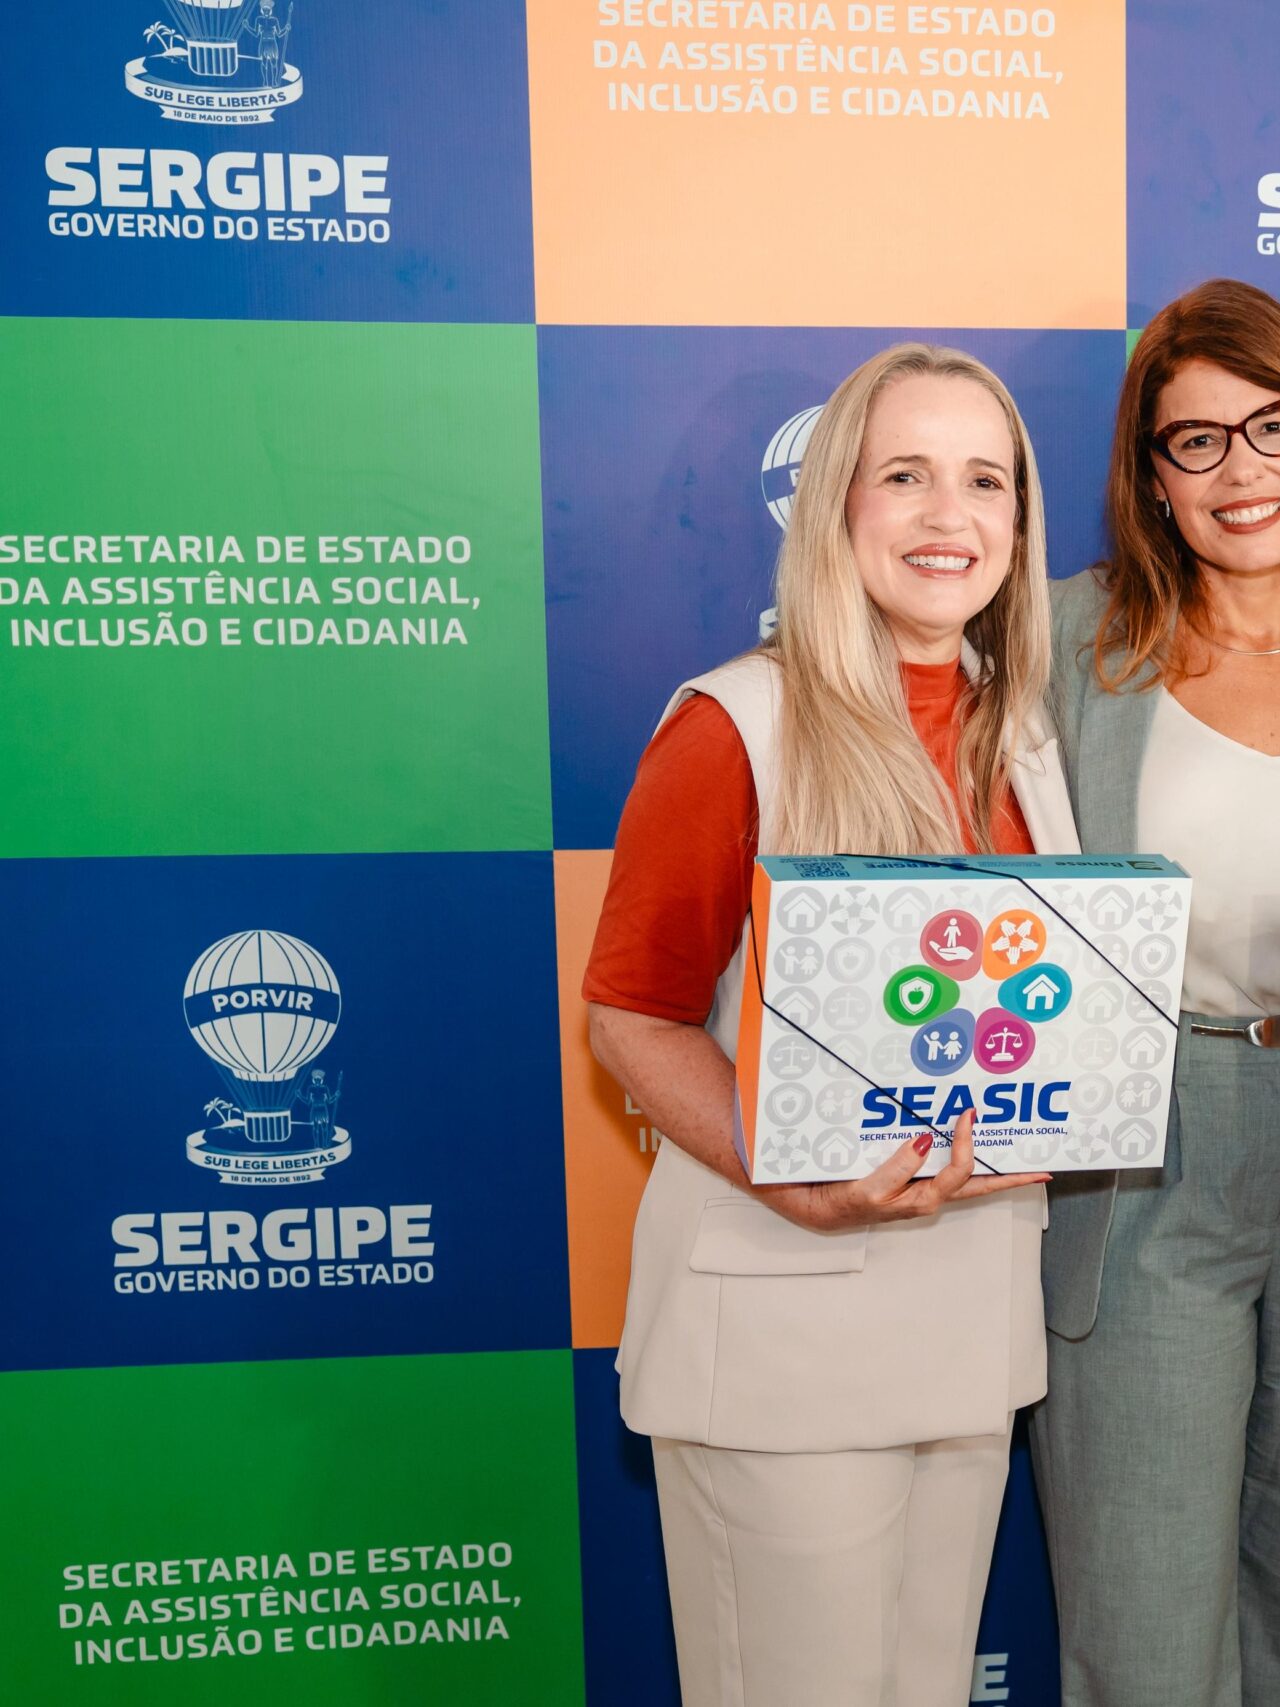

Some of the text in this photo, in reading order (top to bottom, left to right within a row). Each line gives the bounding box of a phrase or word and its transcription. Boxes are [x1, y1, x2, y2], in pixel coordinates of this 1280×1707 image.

[598, 0, 1055, 37] SECRETARIA DE ESTADO
[593, 37, 1063, 84] DA ASSISTÊNCIA SOCIAL,
[144, 87, 286, 107] SUB LEGE LIBERTAS
[608, 78, 1050, 119] INCLUSÃO E CIDADANIA
[200, 113, 222, 121] MAIO
[45, 147, 391, 214] SERGIPE
[49, 212, 390, 243] GOVERNO DO ESTADO
[0, 535, 471, 564] SECRETARIA DE ESTADO
[0, 570, 480, 610] DA ASSISTÊNCIA SOCIAL,
[11, 611, 468, 647] INCLUSÃO E CIDADANIA
[212, 989, 313, 1012] PORVIR
[861, 1082, 1071, 1128] SEASIC
[859, 1133, 912, 1141] SECRETARIA
[979, 1127, 1033, 1136] ASSISTÊNCIA
[1036, 1127, 1068, 1135] SOCIAL,
[975, 1139, 1013, 1147] DADANIA
[204, 1152, 336, 1170] SUB LEGE LIBERTAS
[112, 1204, 434, 1269] SERGIPE
[114, 1262, 434, 1293] GOVERNO DO ESTADO
[63, 1542, 512, 1593] SECRETARIA DE ESTADO
[59, 1580, 521, 1629] DA ASSISTÊNCIA SOCIAL,
[75, 1616, 509, 1665] INCLUSÃO E CIDADANIA
